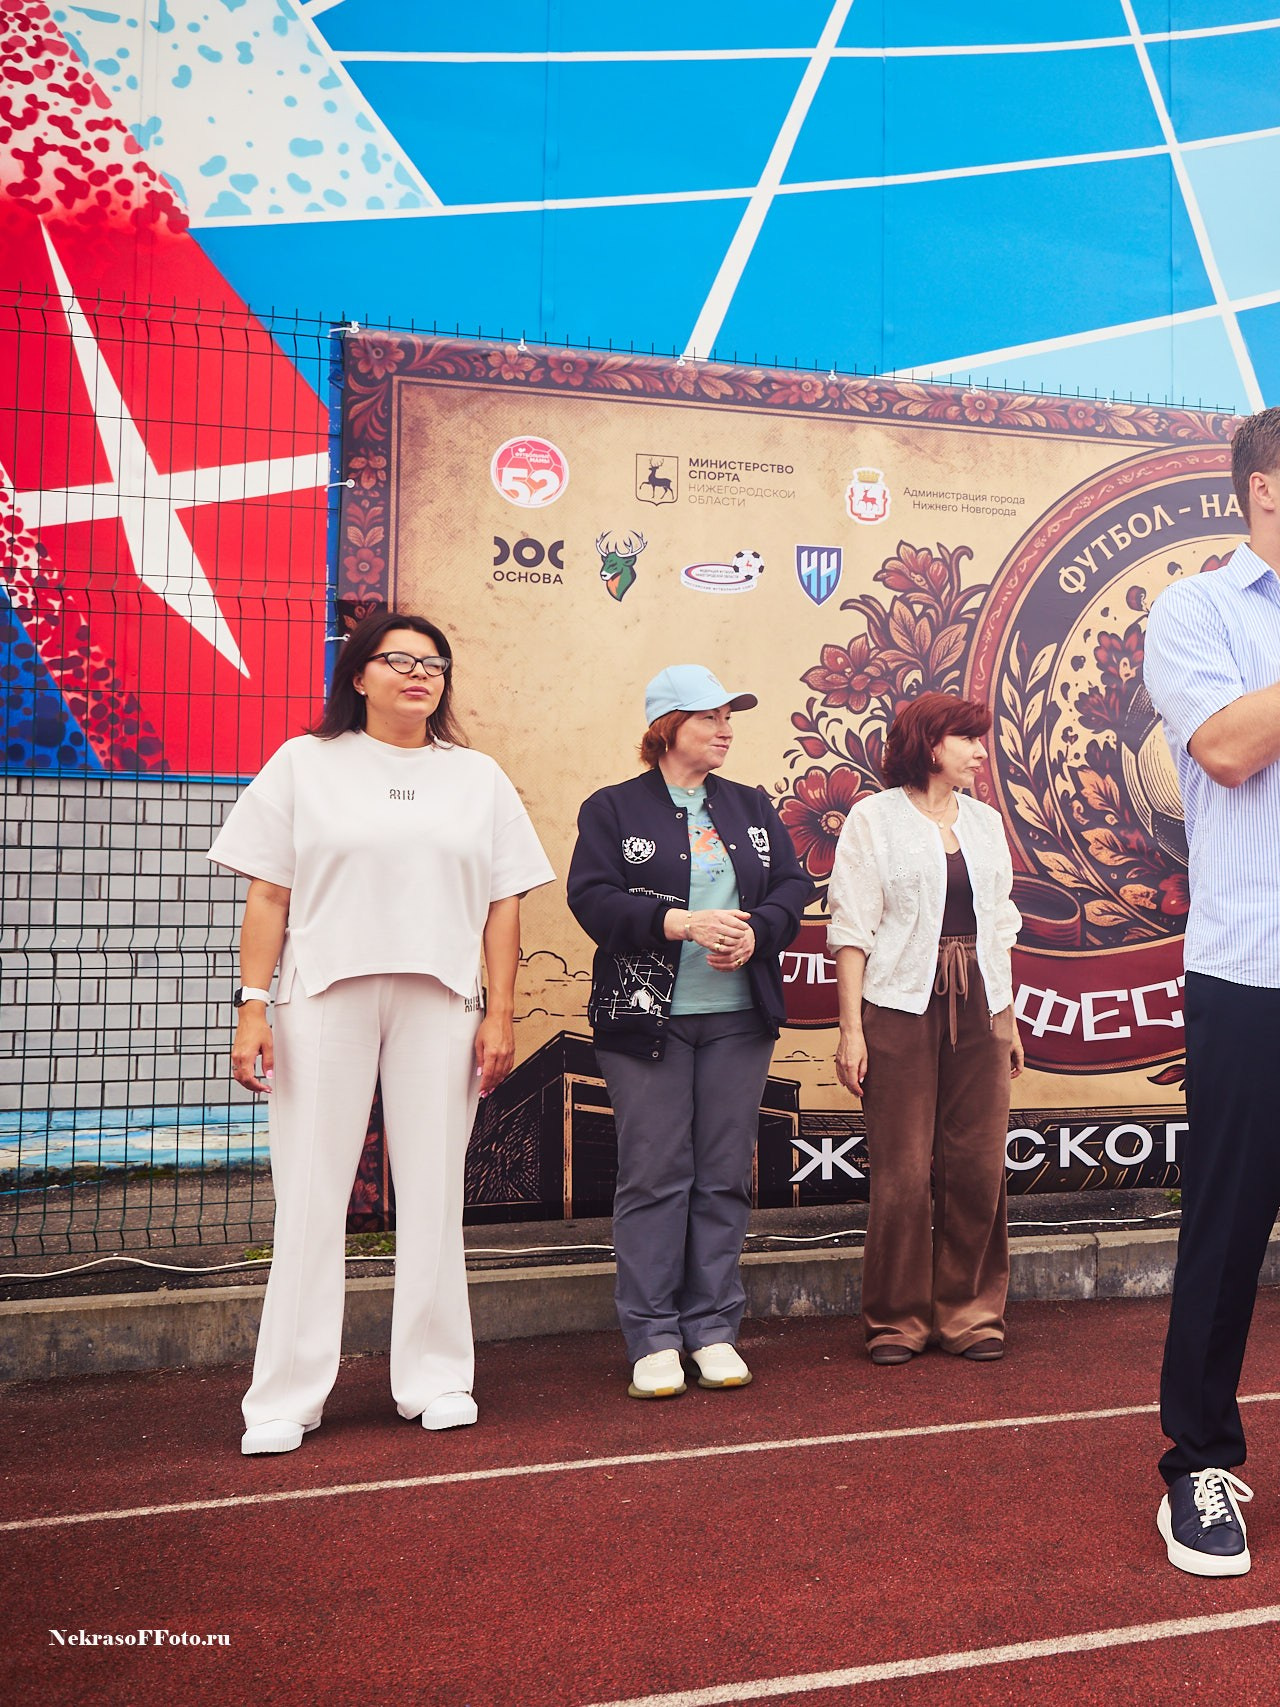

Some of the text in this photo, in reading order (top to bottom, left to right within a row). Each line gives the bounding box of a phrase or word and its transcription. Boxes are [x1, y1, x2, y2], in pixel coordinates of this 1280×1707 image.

[689, 458, 794, 474] МИНИСТЕРСТВО
[688, 470, 740, 482] СПОРТА
[501, 467, 560, 505] 52
[688, 495, 746, 507] ОБЛАСТИ
[904, 487, 1025, 505] Администрация города
[912, 500, 1017, 516] Нижнего Новгорода
[1058, 504, 1175, 594] ФУТБОЛ
[493, 570, 563, 585] ОСНОВА
[1014, 974, 1186, 1042] ФЕС
